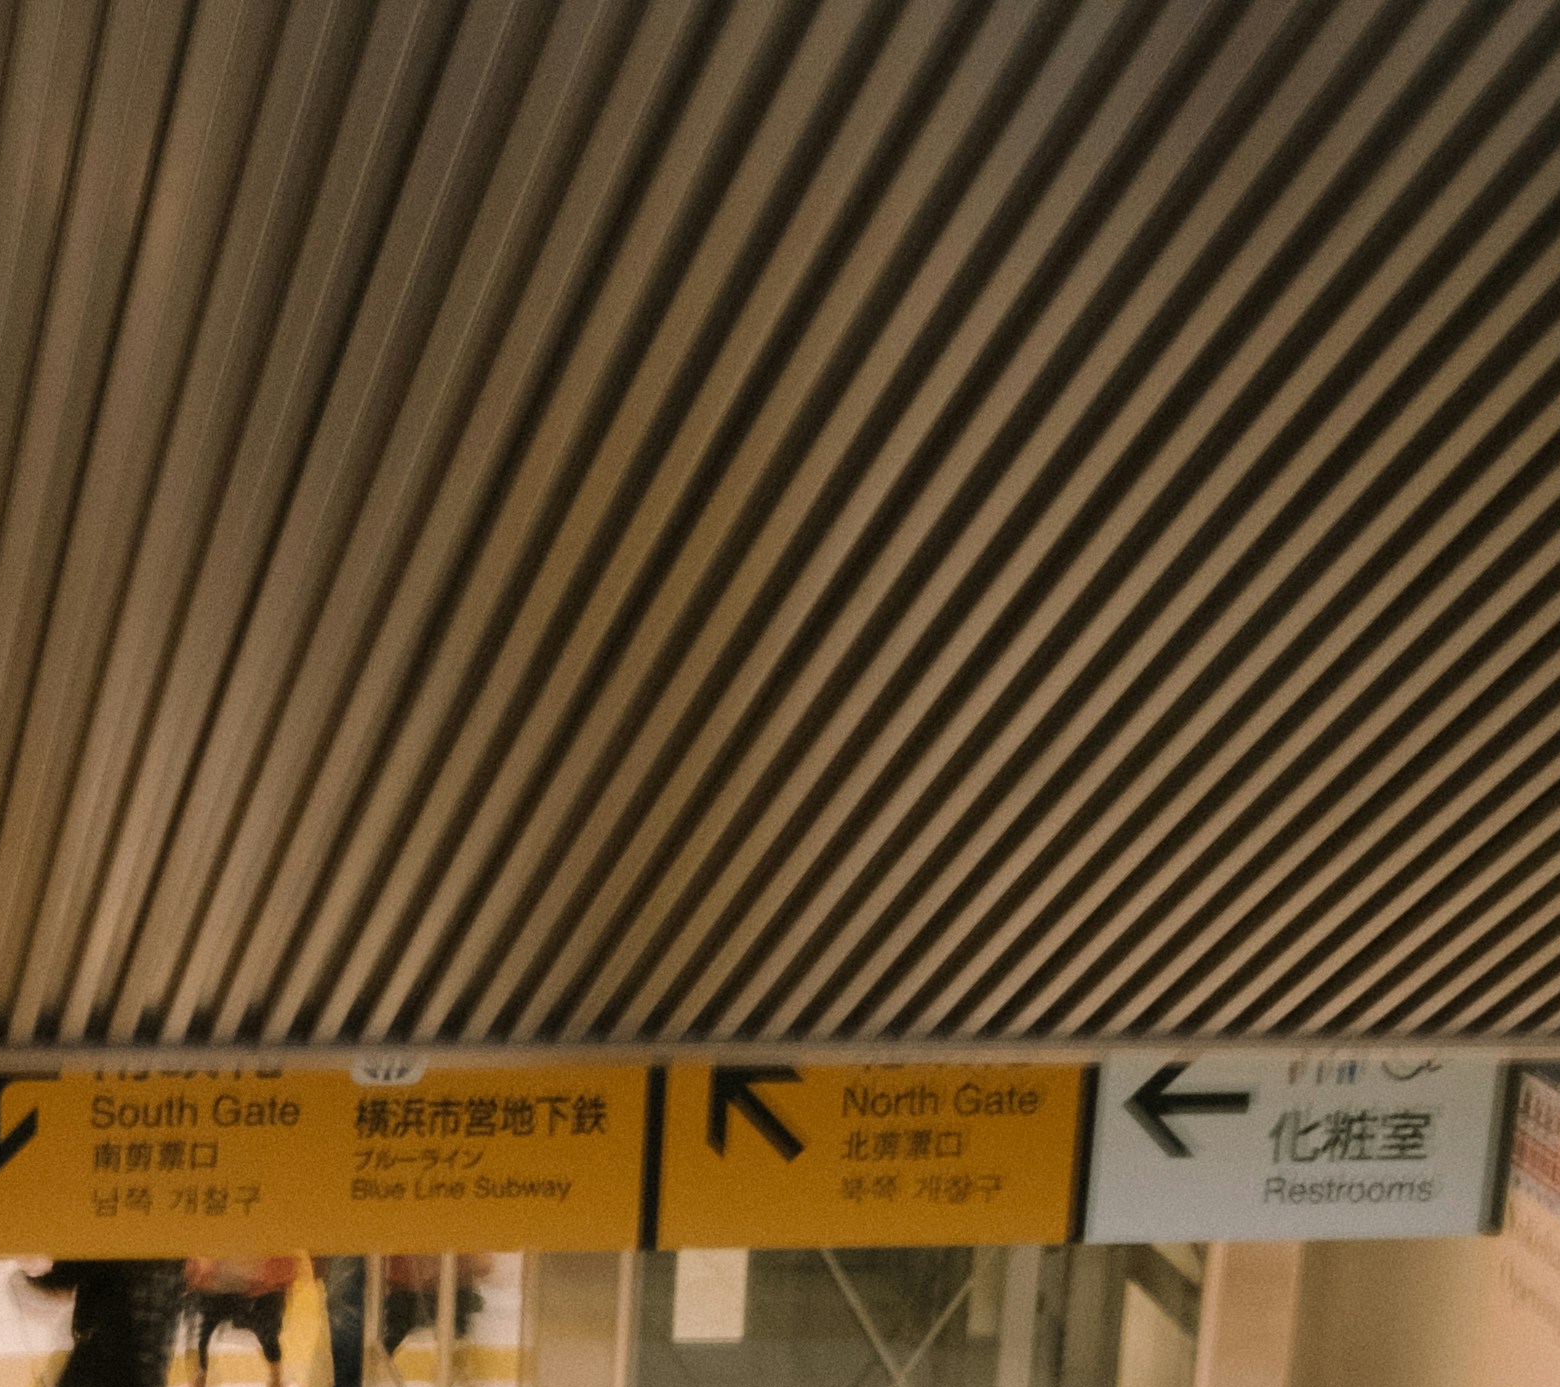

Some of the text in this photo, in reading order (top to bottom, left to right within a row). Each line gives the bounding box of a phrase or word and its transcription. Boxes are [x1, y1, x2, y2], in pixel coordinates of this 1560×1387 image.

[90, 1094, 301, 1129] South Gate
[354, 1094, 609, 1139] 横浜市営地下鉄
[841, 1082, 1042, 1118] North Gate
[1268, 1110, 1433, 1163] 化粧室
[353, 1147, 485, 1171] ブルーライン
[351, 1175, 573, 1204] Blue Line Subway
[1263, 1176, 1436, 1205] Restrooms
